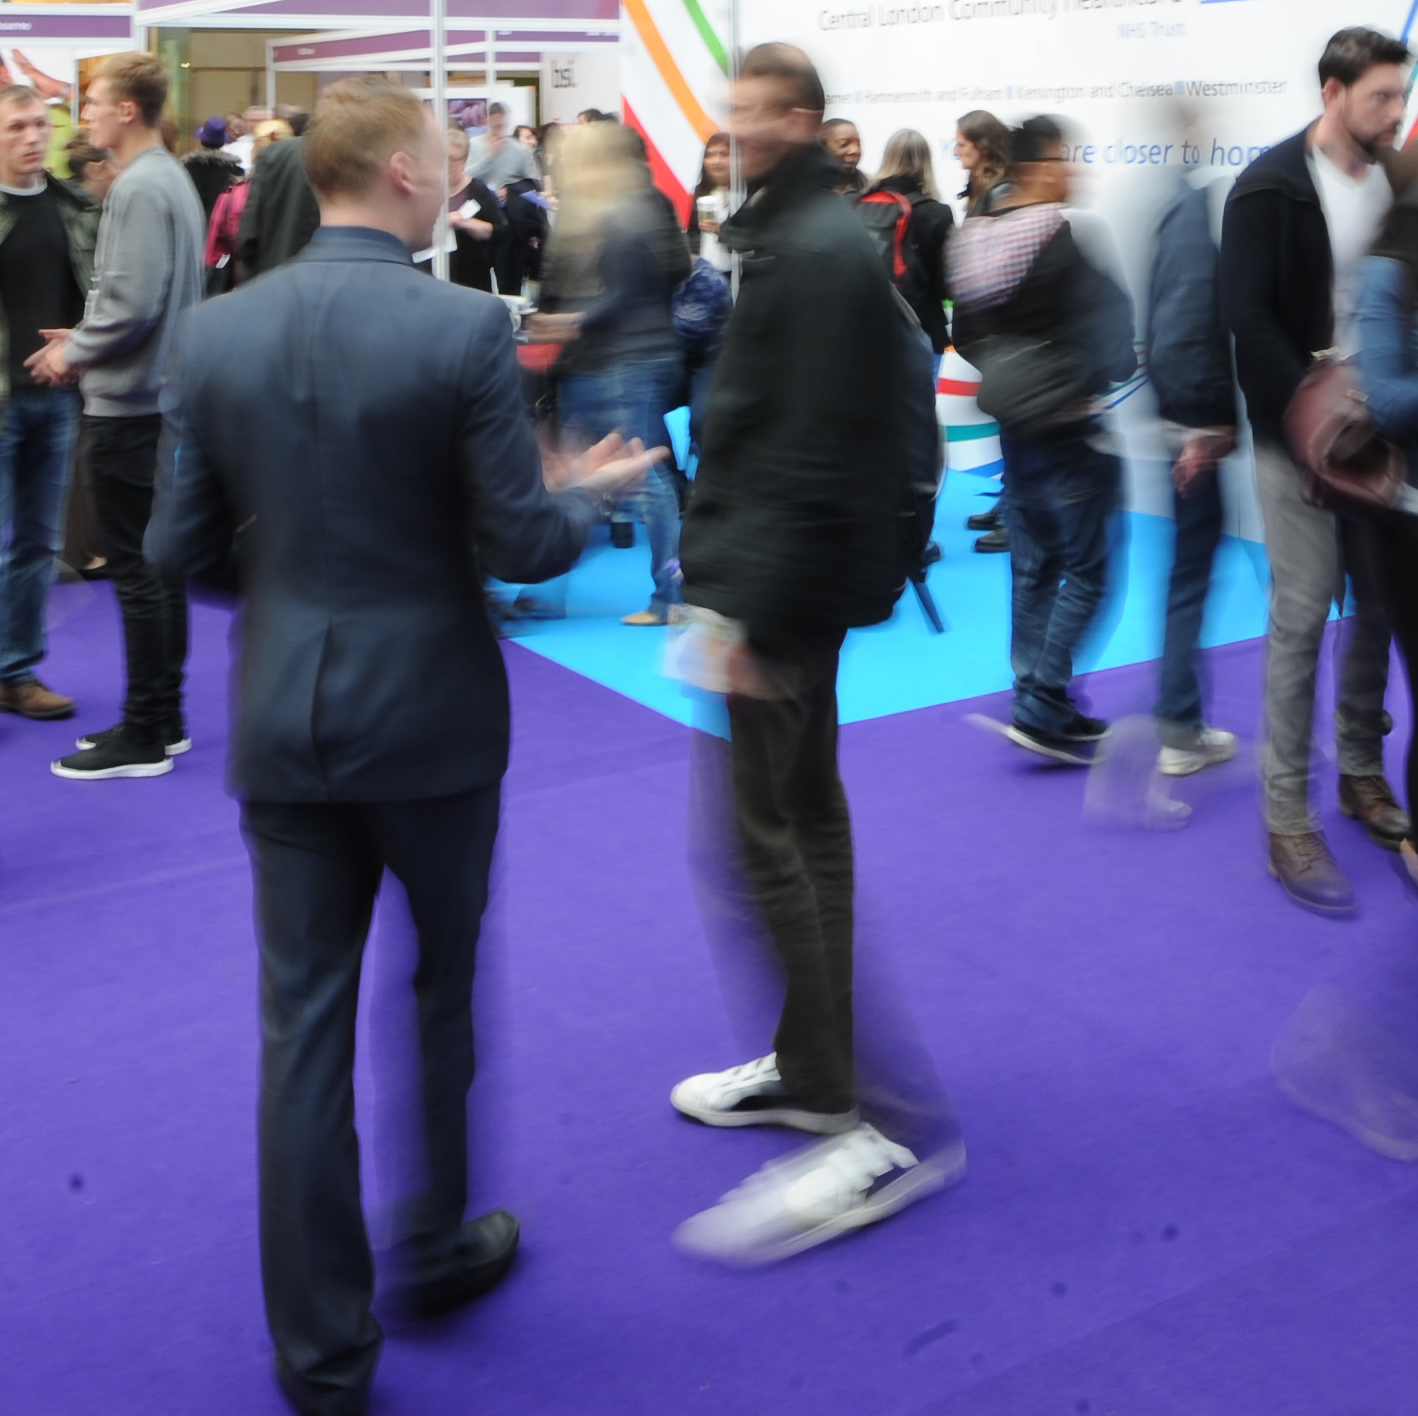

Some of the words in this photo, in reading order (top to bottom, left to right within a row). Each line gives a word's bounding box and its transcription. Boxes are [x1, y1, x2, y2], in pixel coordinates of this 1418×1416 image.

[817, 4, 875, 31] Central
[878, 0, 945, 27] London
[1089, 83, 1113, 100] and
[1116, 80, 1174, 99] Chelsea
[1185, 78, 1289, 98] Westminster
[1102, 136, 1174, 166] closer
[1181, 139, 1201, 165] to
[1209, 137, 1275, 167] hom
